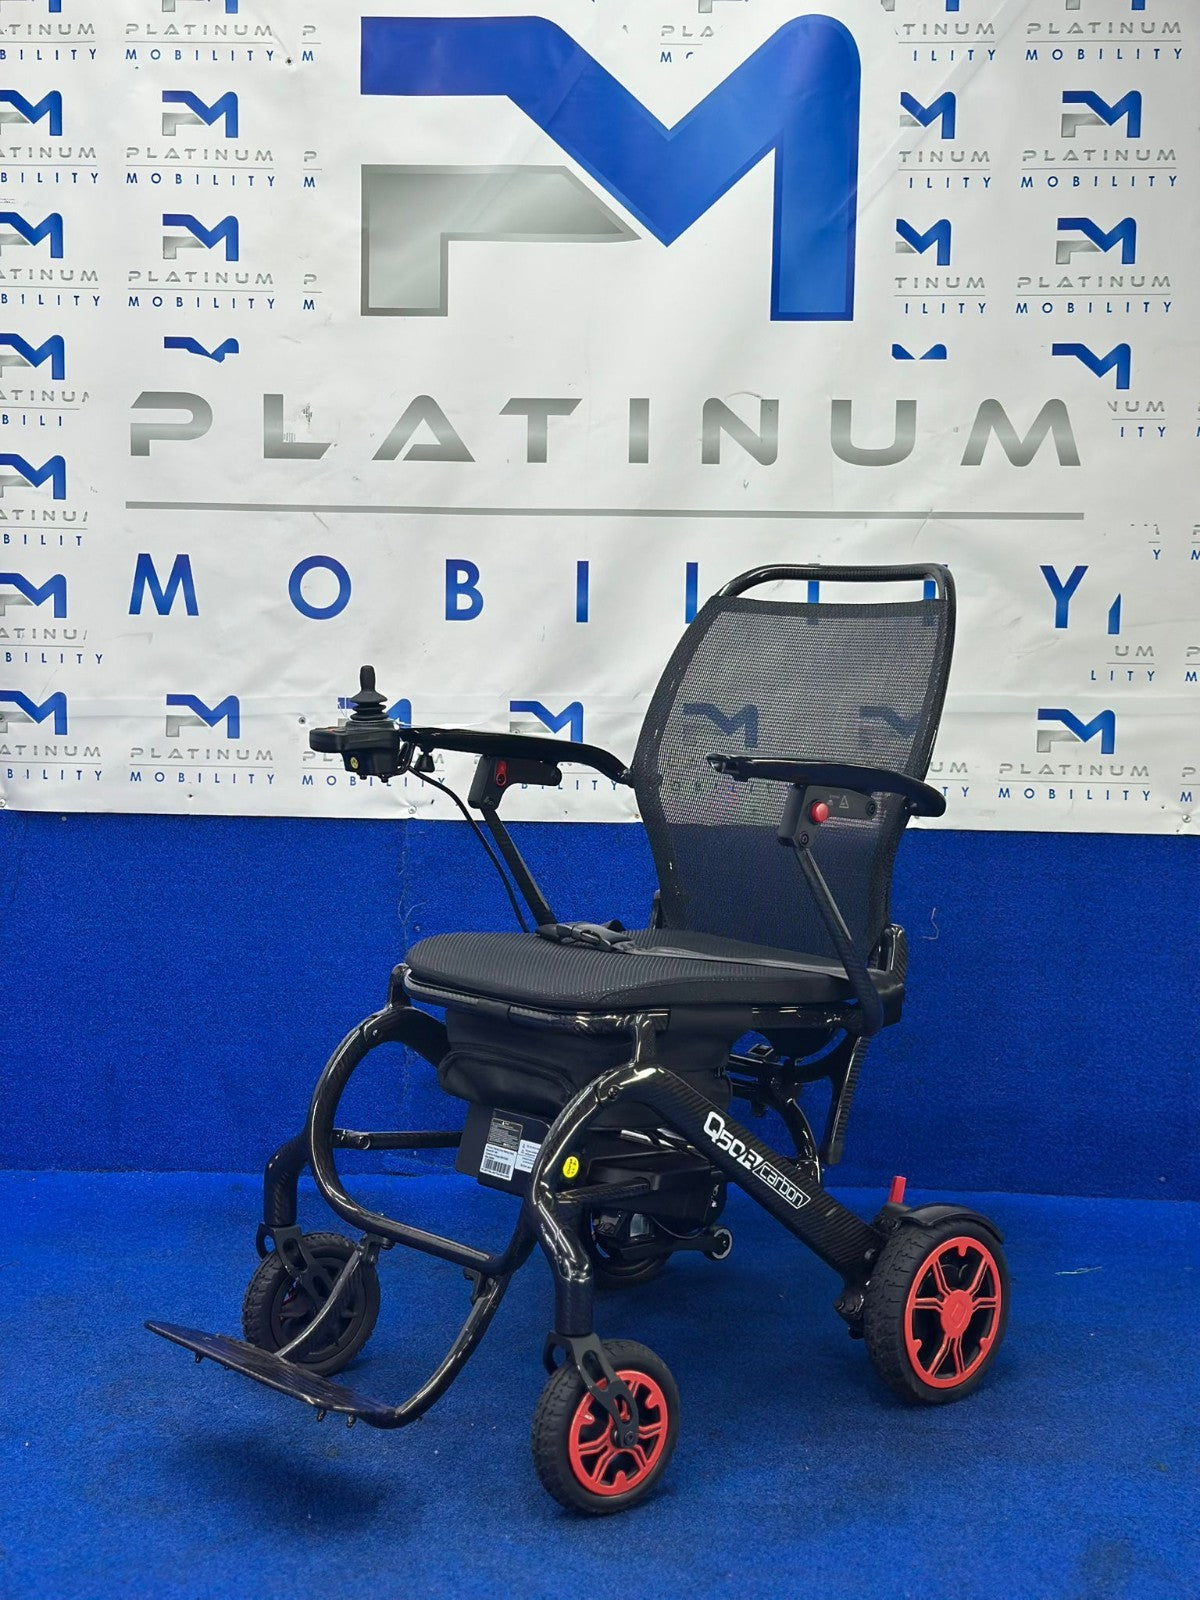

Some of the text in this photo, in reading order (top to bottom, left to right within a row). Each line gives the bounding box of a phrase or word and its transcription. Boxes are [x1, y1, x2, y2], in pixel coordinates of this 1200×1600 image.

[126, 24, 272, 36] PLATINUM
[1027, 22, 1181, 34] PLATINUM
[125, 49, 274, 61] MOBILITY
[1026, 48, 1182, 60] MOBILITY
[126, 147, 273, 161] PLATINUM
[1023, 149, 1176, 161] PLATINUM
[126, 172, 275, 187] MOBILITY
[1021, 175, 1177, 188] MOBILITY
[128, 271, 273, 284] PLATINUM
[1017, 276, 1170, 288] PLATINUM
[128, 296, 275, 309] MOBILITY
[1016, 302, 1172, 313] MOBILITY
[130, 392, 1081, 467] PLATINUM
[130, 748, 273, 760] PLATINUM
[1000, 763, 1149, 776] PLATINUM
[130, 771, 274, 784] MOBILITY
[998, 788, 1150, 801] MOBILITY
